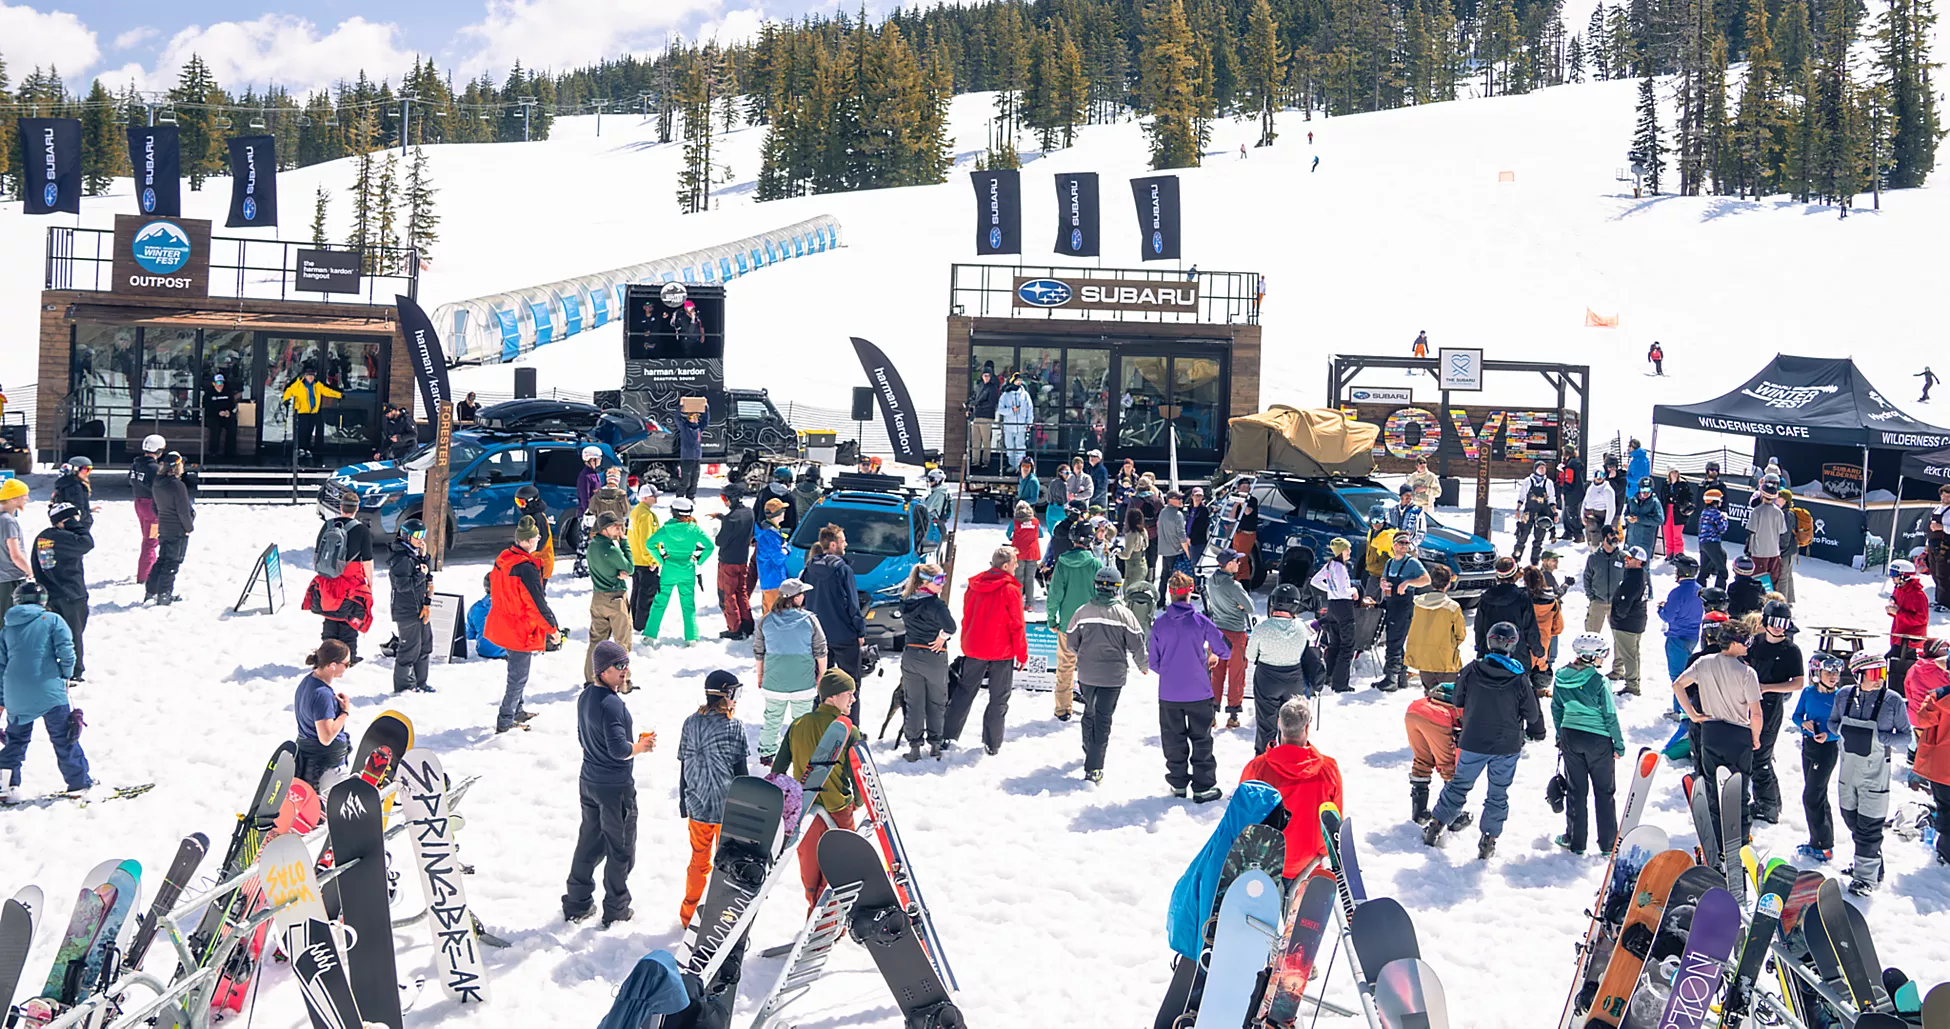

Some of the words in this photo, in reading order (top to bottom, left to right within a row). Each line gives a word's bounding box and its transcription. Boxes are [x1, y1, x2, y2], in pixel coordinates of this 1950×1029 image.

[44, 128, 56, 181] SUBARU
[145, 135, 154, 186] SUBARU
[246, 146, 254, 195] SUBARU
[991, 178, 999, 225] SUBARU
[1071, 180, 1079, 226] SUBARU
[1151, 184, 1160, 229] SUBARU
[144, 249, 181, 258] WINTER
[155, 257, 181, 265] FEST
[129, 275, 192, 289] OUTPOST
[1081, 285, 1195, 306] SUBARU
[414, 328, 441, 416] harman/kardo
[1372, 392, 1409, 401] SUBARU
[1755, 384, 1820, 403] WINTER
[1765, 398, 1811, 409] FEST
[438, 405, 452, 467] FORESTER
[1698, 416, 1774, 435] WILDERNESS
[1775, 425, 1810, 438] CAFE
[1881, 432, 1941, 448] WILDERNESS
[1479, 446, 1489, 500] OUTBACK
[1823, 470, 1864, 480] WILDERNES
[1832, 465, 1861, 475] SUBARU
[1728, 507, 1753, 519] WINT
[1821, 537, 1839, 547] Flask
